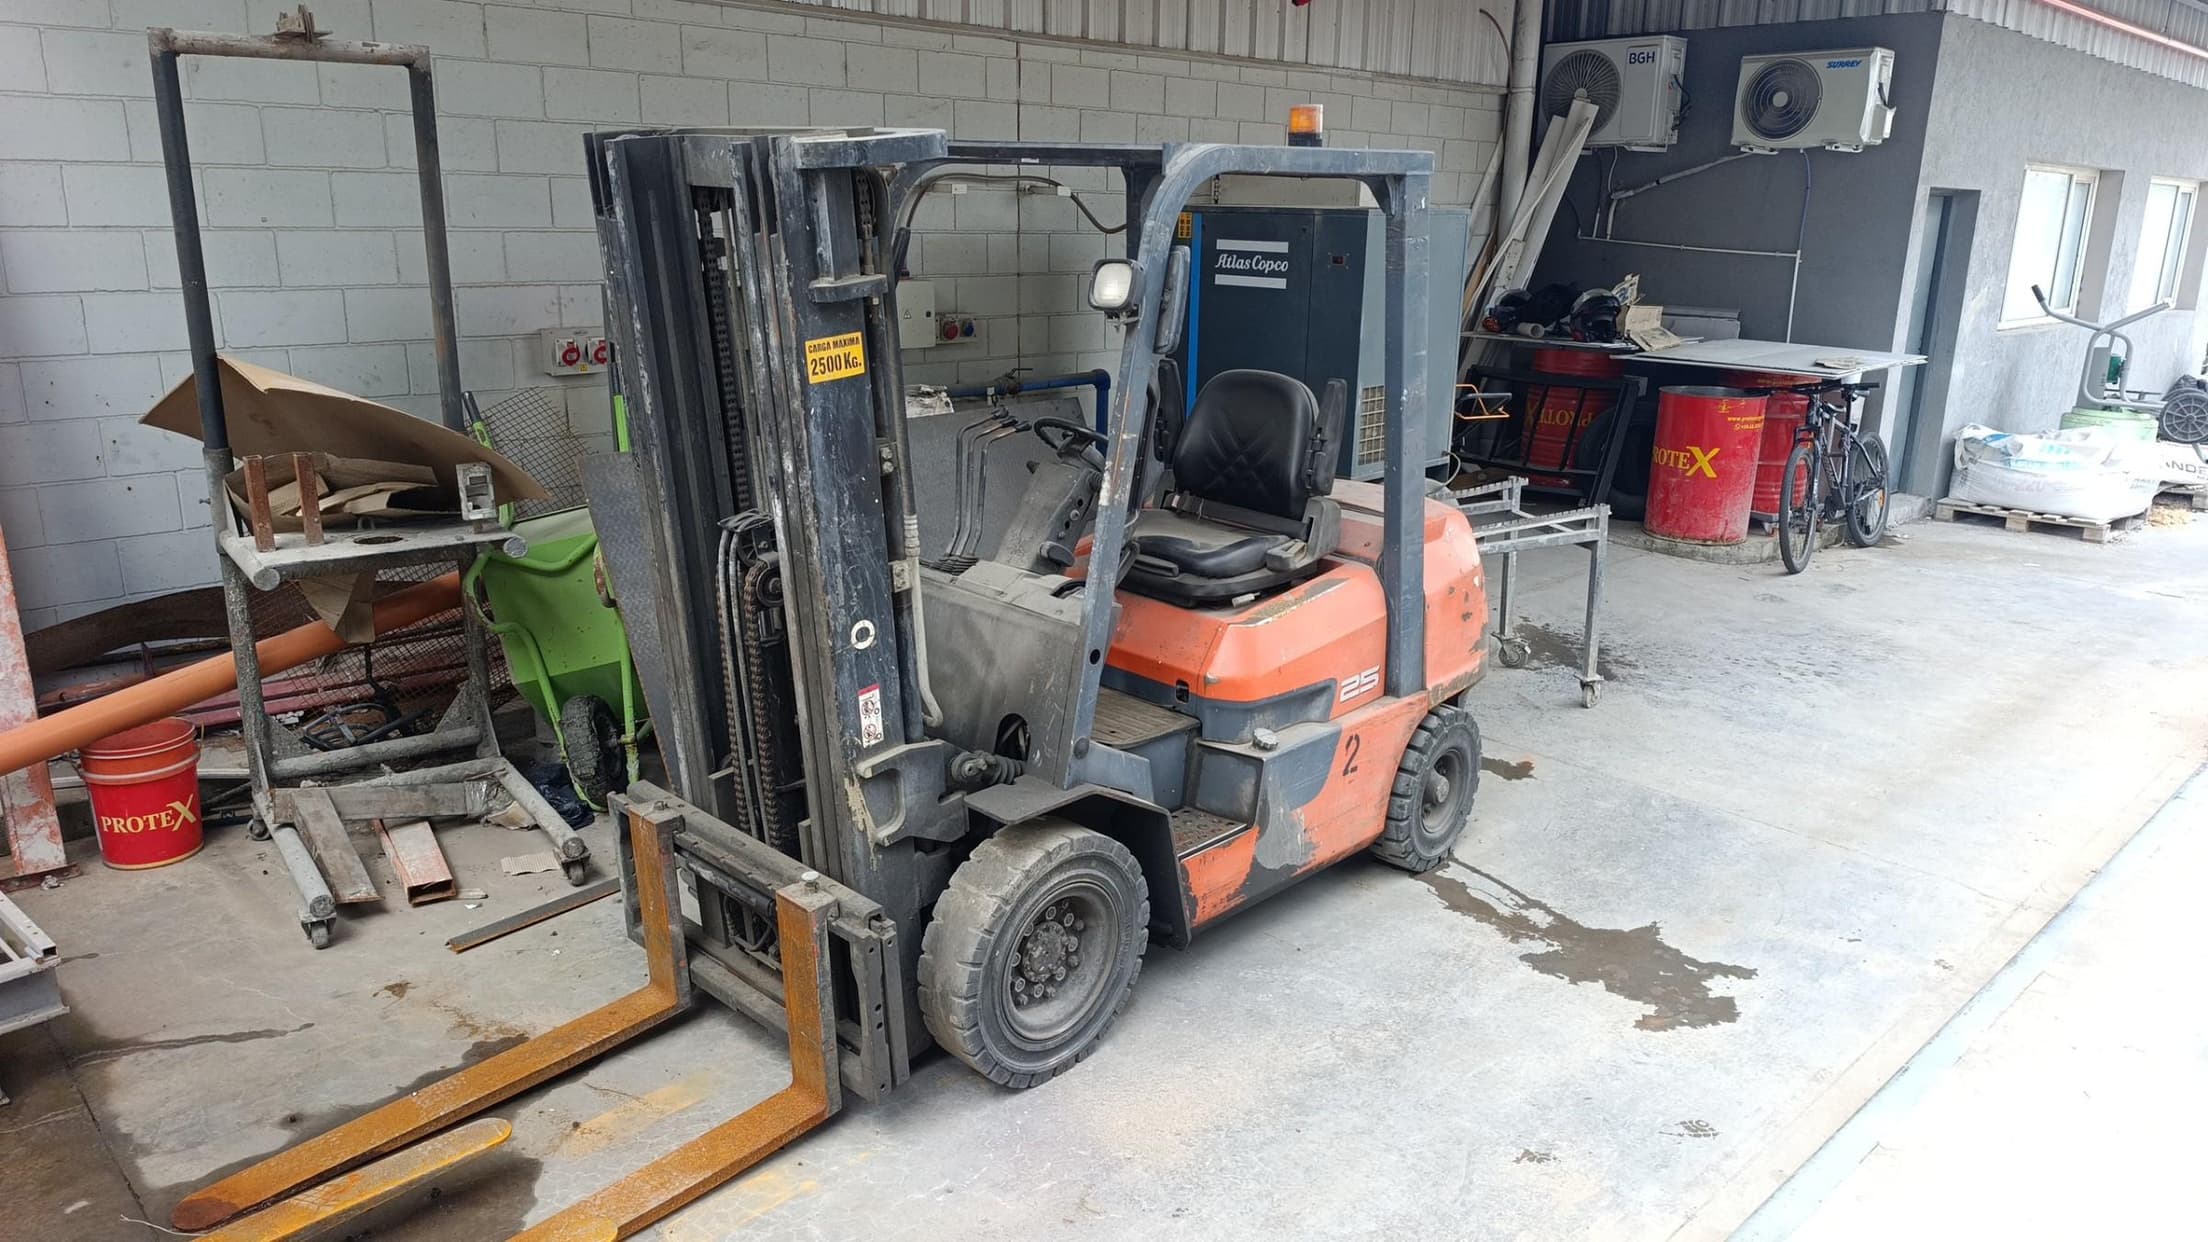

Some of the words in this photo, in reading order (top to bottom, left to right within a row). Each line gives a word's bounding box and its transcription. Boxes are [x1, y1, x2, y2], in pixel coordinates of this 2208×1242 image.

[1629, 51, 1656, 65] BGH
[808, 341, 832, 353] CARGA
[810, 354, 842, 376] 2500
[1340, 664, 1380, 703] 25
[1342, 733, 1361, 777] 2
[101, 793, 197, 834] PROTEX
